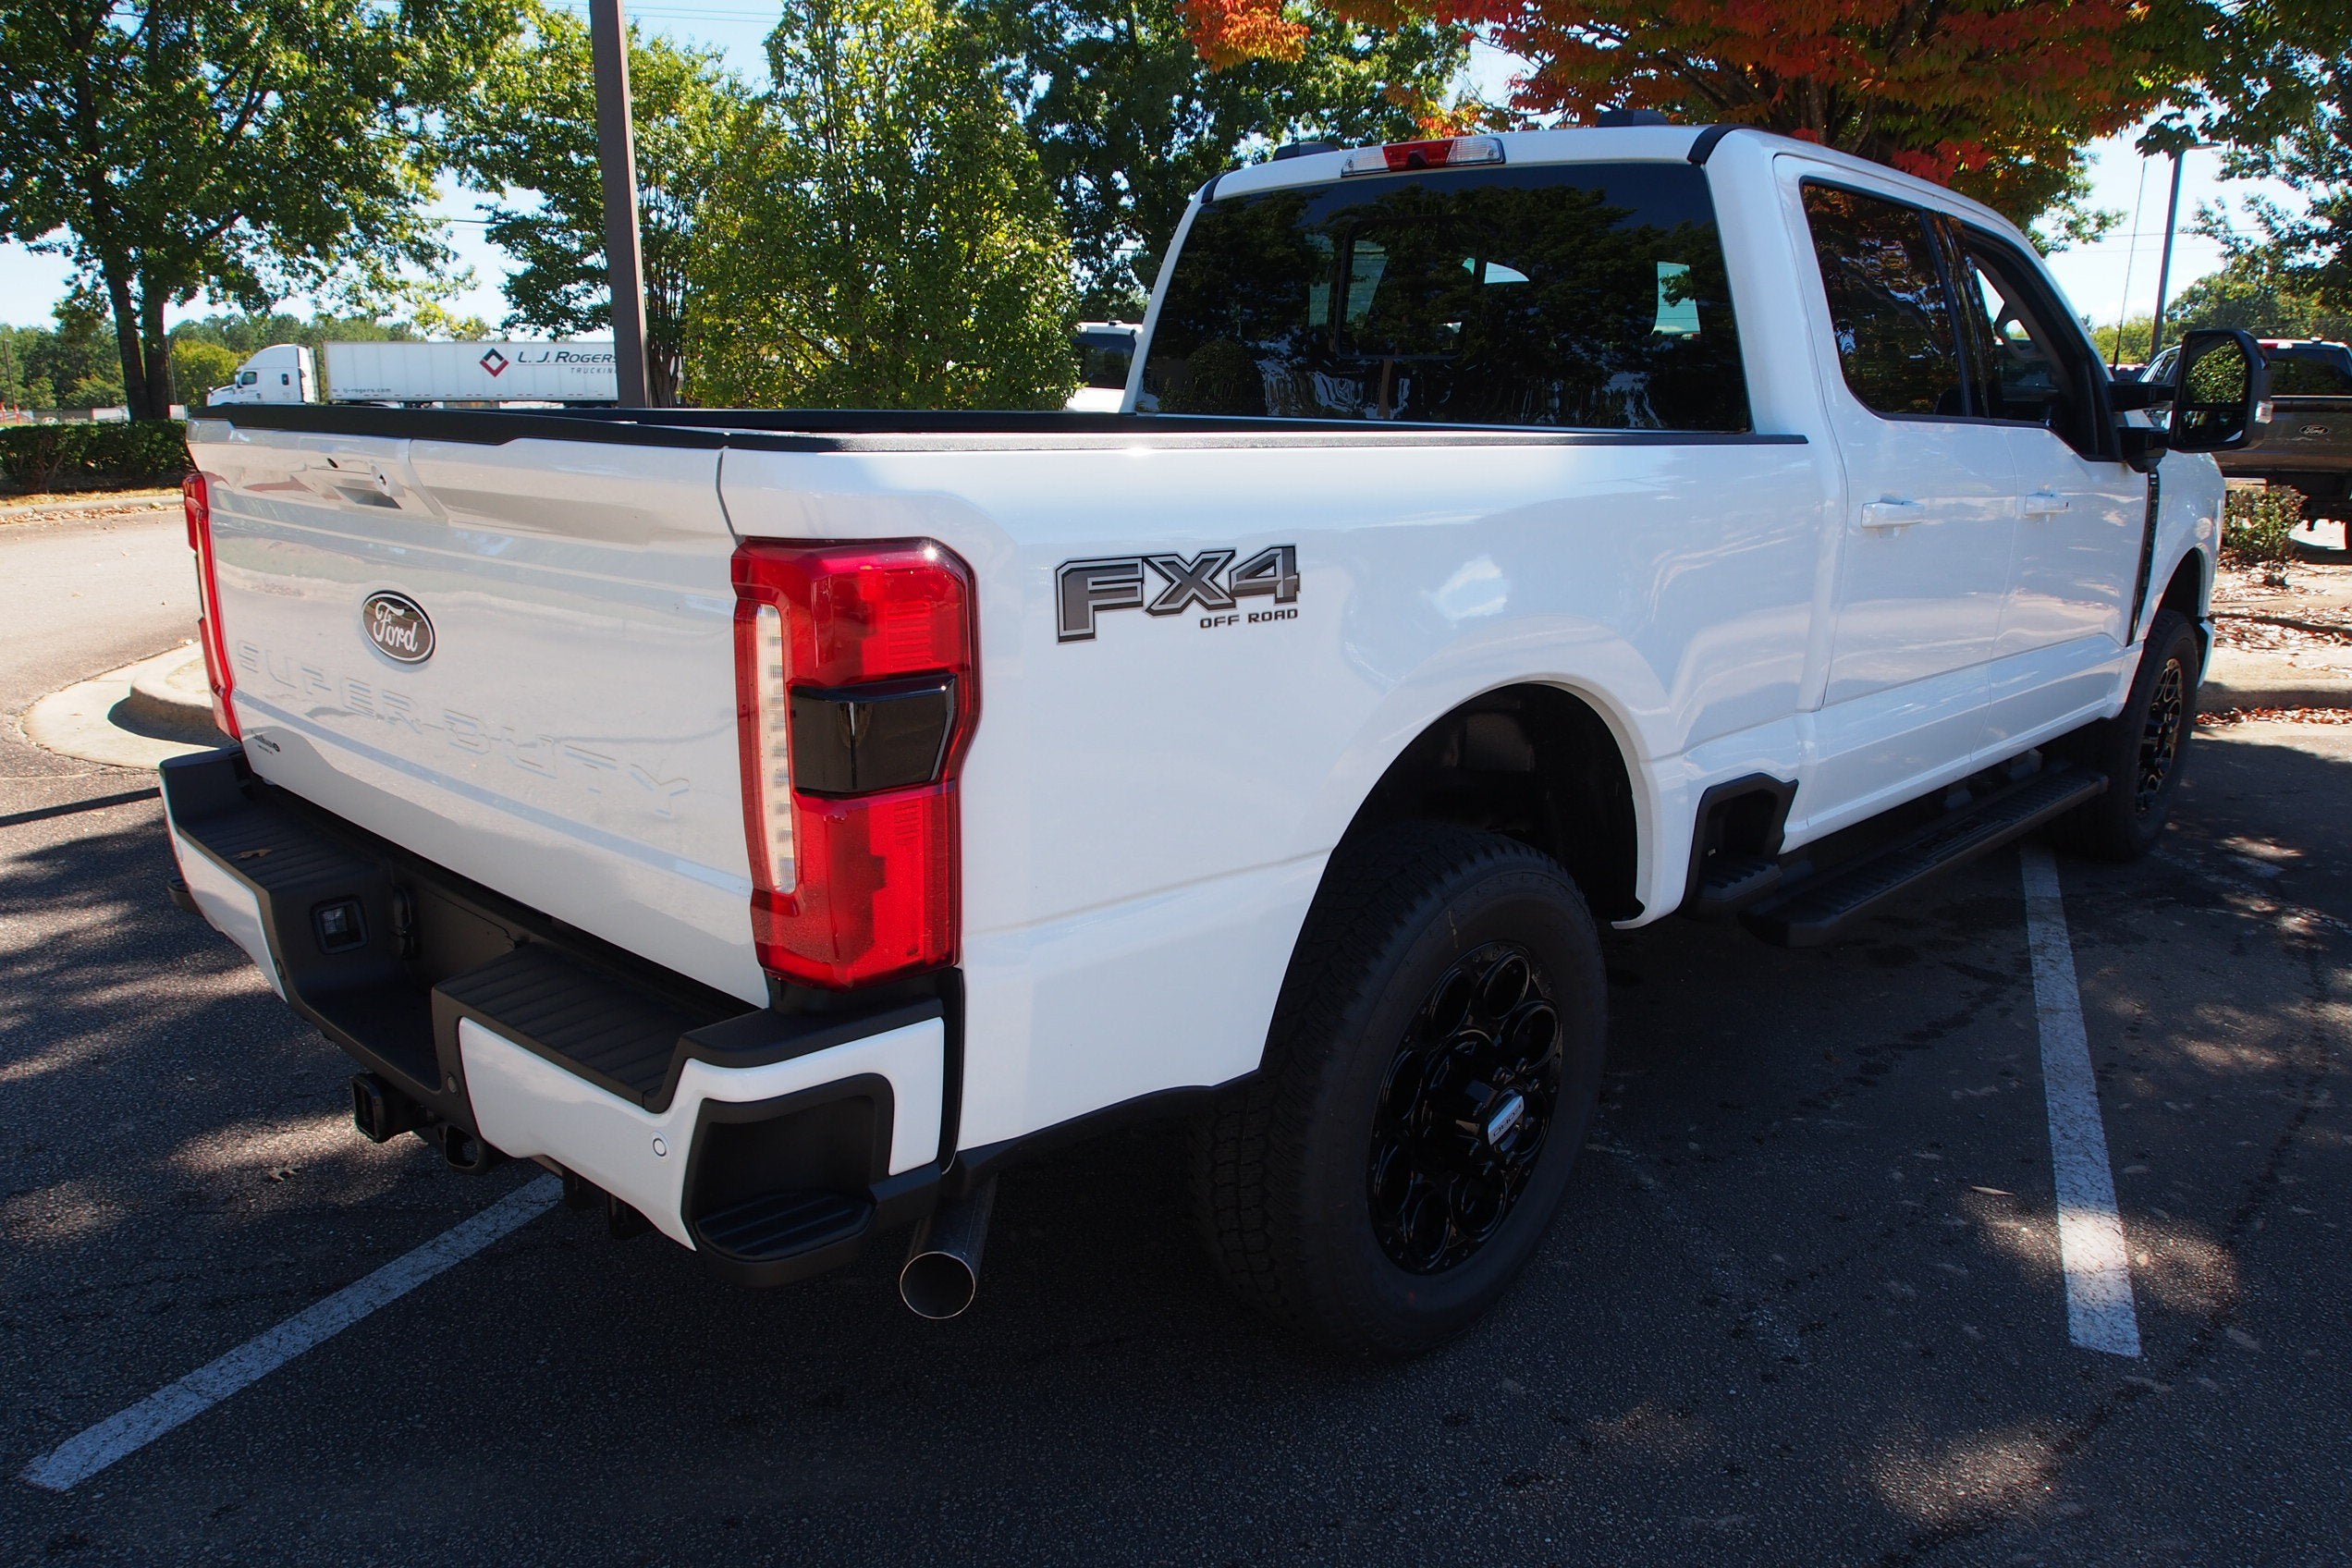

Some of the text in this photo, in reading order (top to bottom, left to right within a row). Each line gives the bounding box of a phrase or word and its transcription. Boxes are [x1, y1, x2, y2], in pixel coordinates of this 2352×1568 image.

[517, 350, 532, 363] L.
[535, 350, 551, 363] J.
[2302, 425, 2327, 435] Ford
[1054, 543, 1301, 645] FX4
[373, 601, 419, 653] Ford
[1199, 607, 1298, 629] OFF ROAD
[237, 639, 692, 817] SUPER DUTY
